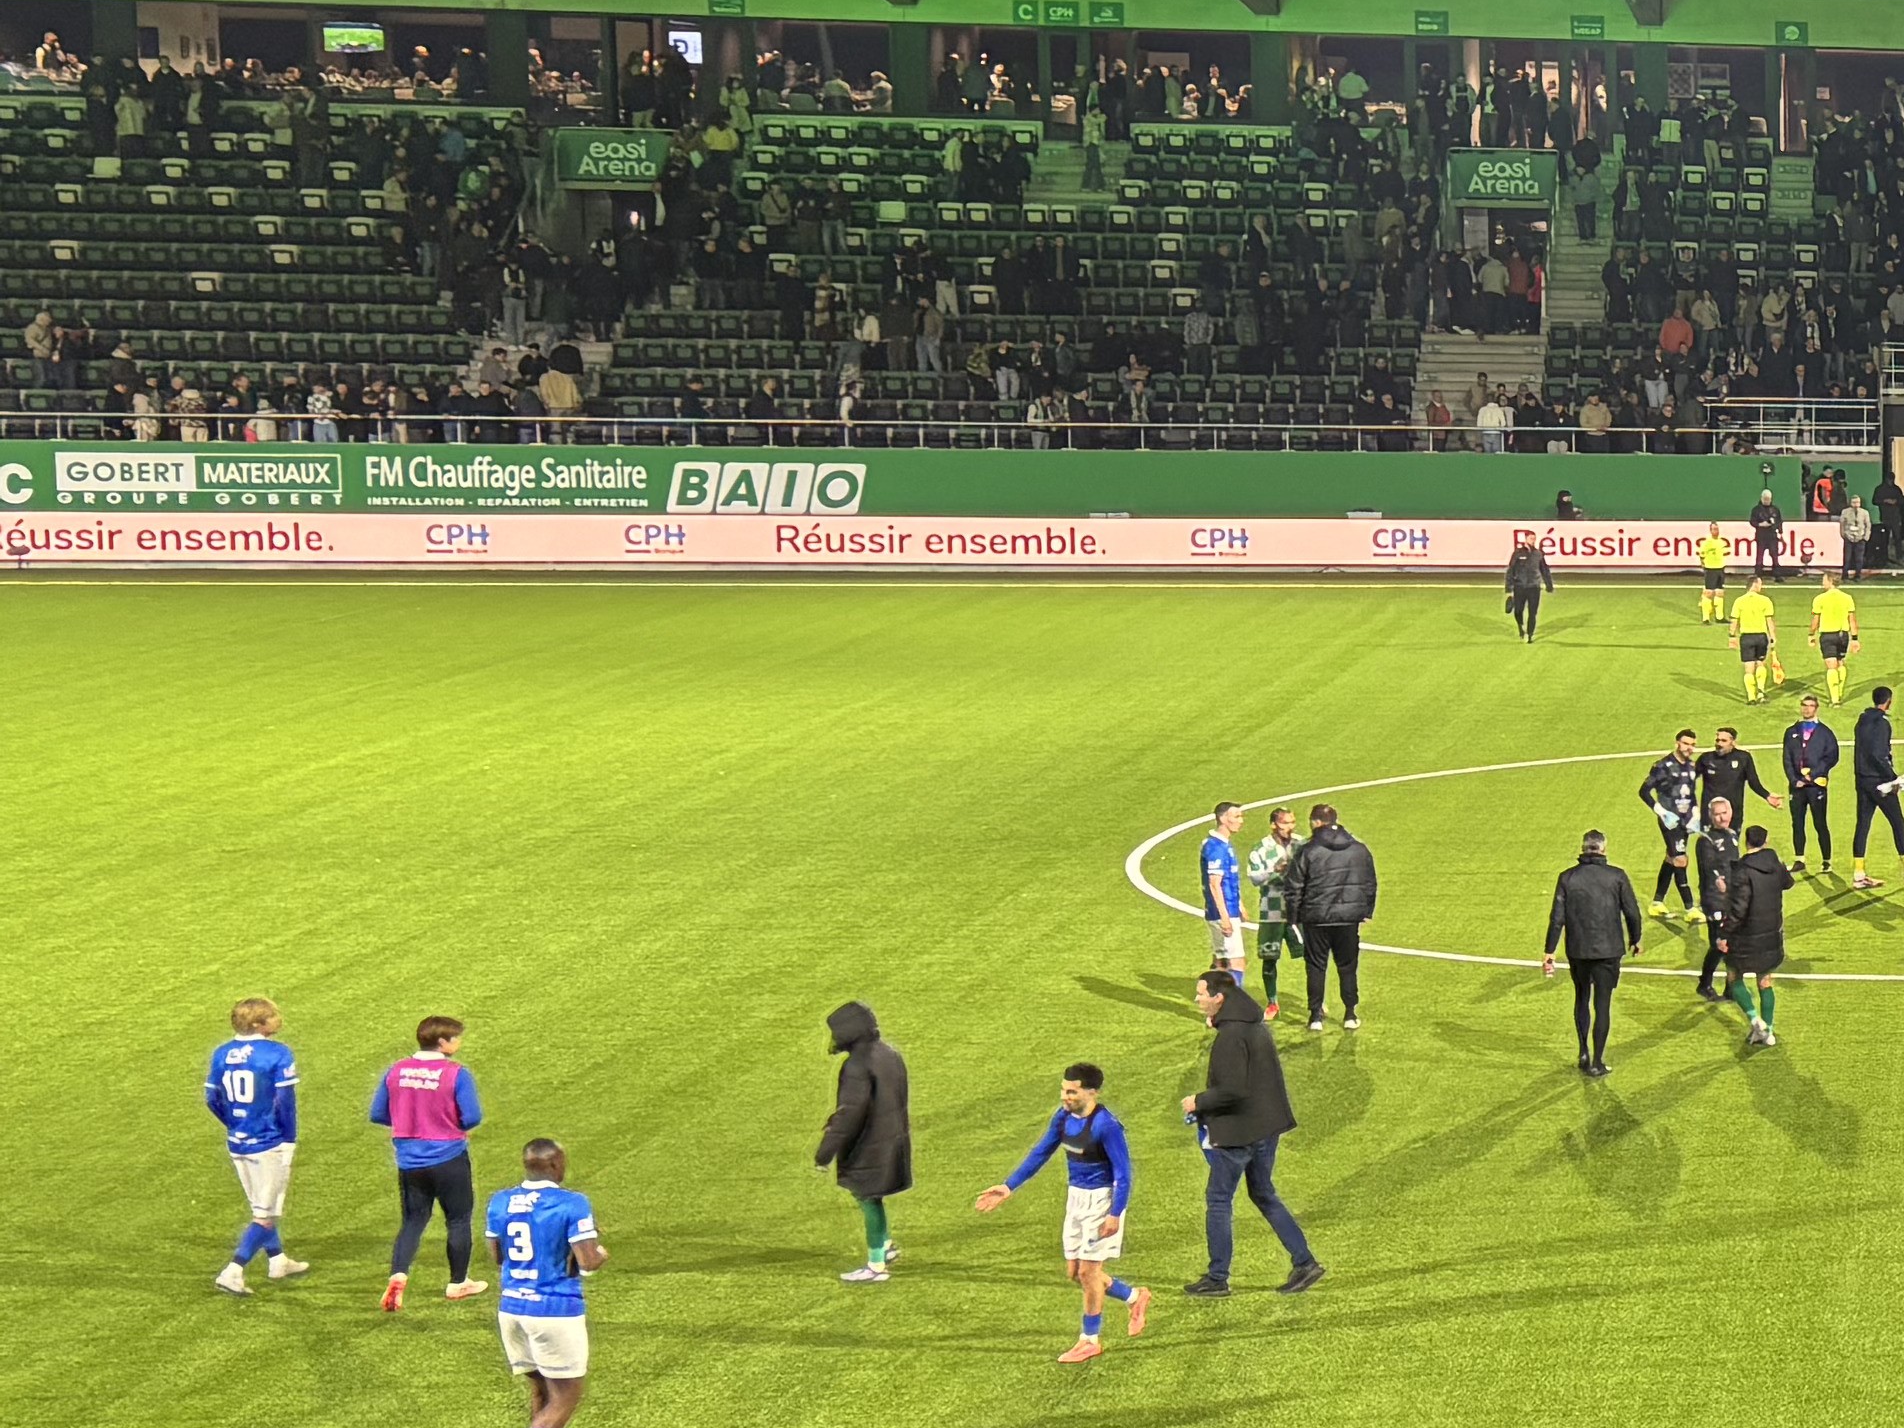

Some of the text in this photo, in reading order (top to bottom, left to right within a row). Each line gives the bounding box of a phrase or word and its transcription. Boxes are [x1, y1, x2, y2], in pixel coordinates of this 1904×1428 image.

[1018, 4, 1033, 20] C
[589, 138, 646, 159] easi
[578, 155, 656, 176] Arena
[1478, 158, 1530, 178] easi
[1468, 174, 1539, 194] Arena
[66, 461, 331, 485] GOBERT MATERIAUX
[365, 456, 648, 496] FM Chauffage Sanitaire
[57, 492, 343, 506] GROUPE GOBERT
[676, 468, 859, 509] BAIO
[367, 497, 465, 506] INSTALLATION
[574, 499, 649, 508] ENTRETIEN
[0, 519, 334, 552] éussir ensemble.
[426, 524, 490, 546] CPH
[624, 523, 686, 546] CPH
[776, 523, 1107, 556] Réussir ensemble.
[1190, 528, 1250, 549] CPH
[1372, 528, 1429, 550] CPH
[221, 1069, 255, 1104] 10
[507, 1221, 533, 1262] 3
